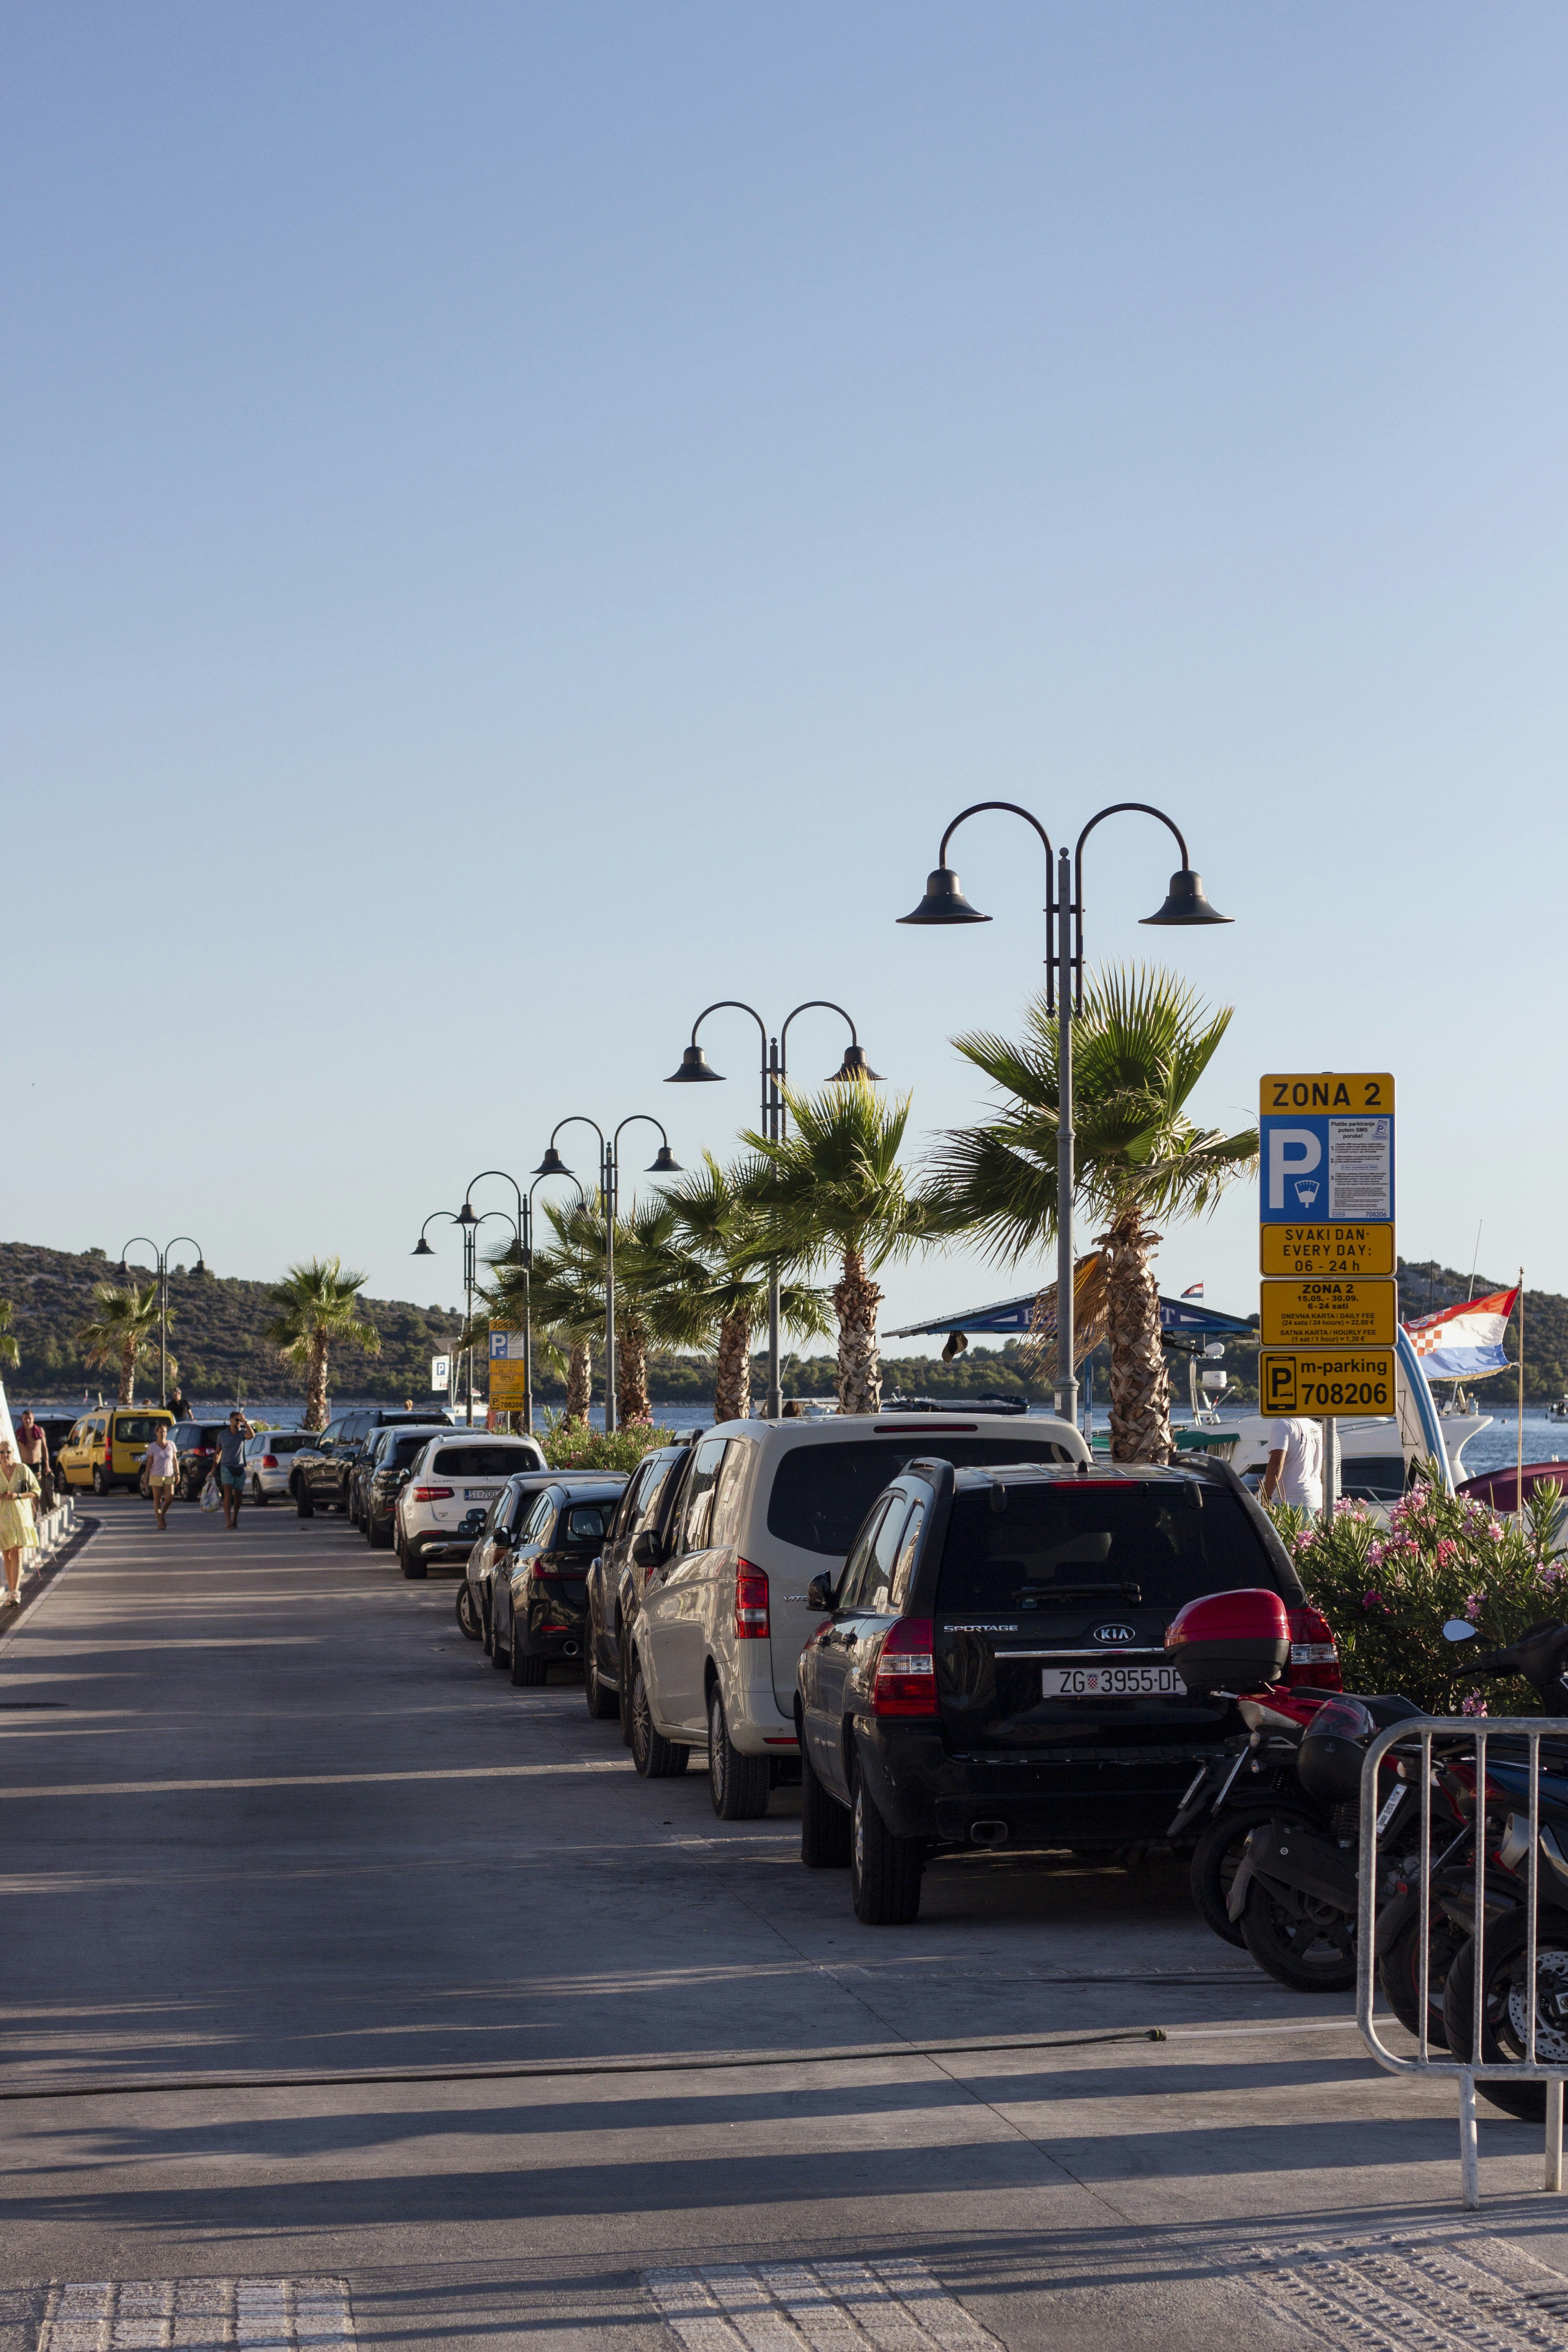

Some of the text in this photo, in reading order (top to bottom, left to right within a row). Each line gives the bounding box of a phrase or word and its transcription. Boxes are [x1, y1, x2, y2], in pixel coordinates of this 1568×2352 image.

[1273, 1082, 1381, 1107] ZONA 2
[1269, 1129, 1321, 1208] P
[1285, 1229, 1330, 1240] SVAKI
[1283, 1245, 1372, 1256] EVERY DAY:
[1295, 1260, 1313, 1271] 06
[1329, 1260, 1347, 1271] 24
[1352, 1260, 1360, 1271] h
[1303, 1284, 1353, 1294] ZONA 2
[492, 1334, 506, 1356] P
[438, 1363, 444, 1375] P
[1272, 1358, 1387, 1397] P m-parking
[1301, 1383, 1387, 1405] 708206
[493, 1397, 498, 1406] P
[1101, 1628, 1129, 1640] KIA
[1059, 1671, 1085, 1693] ZG
